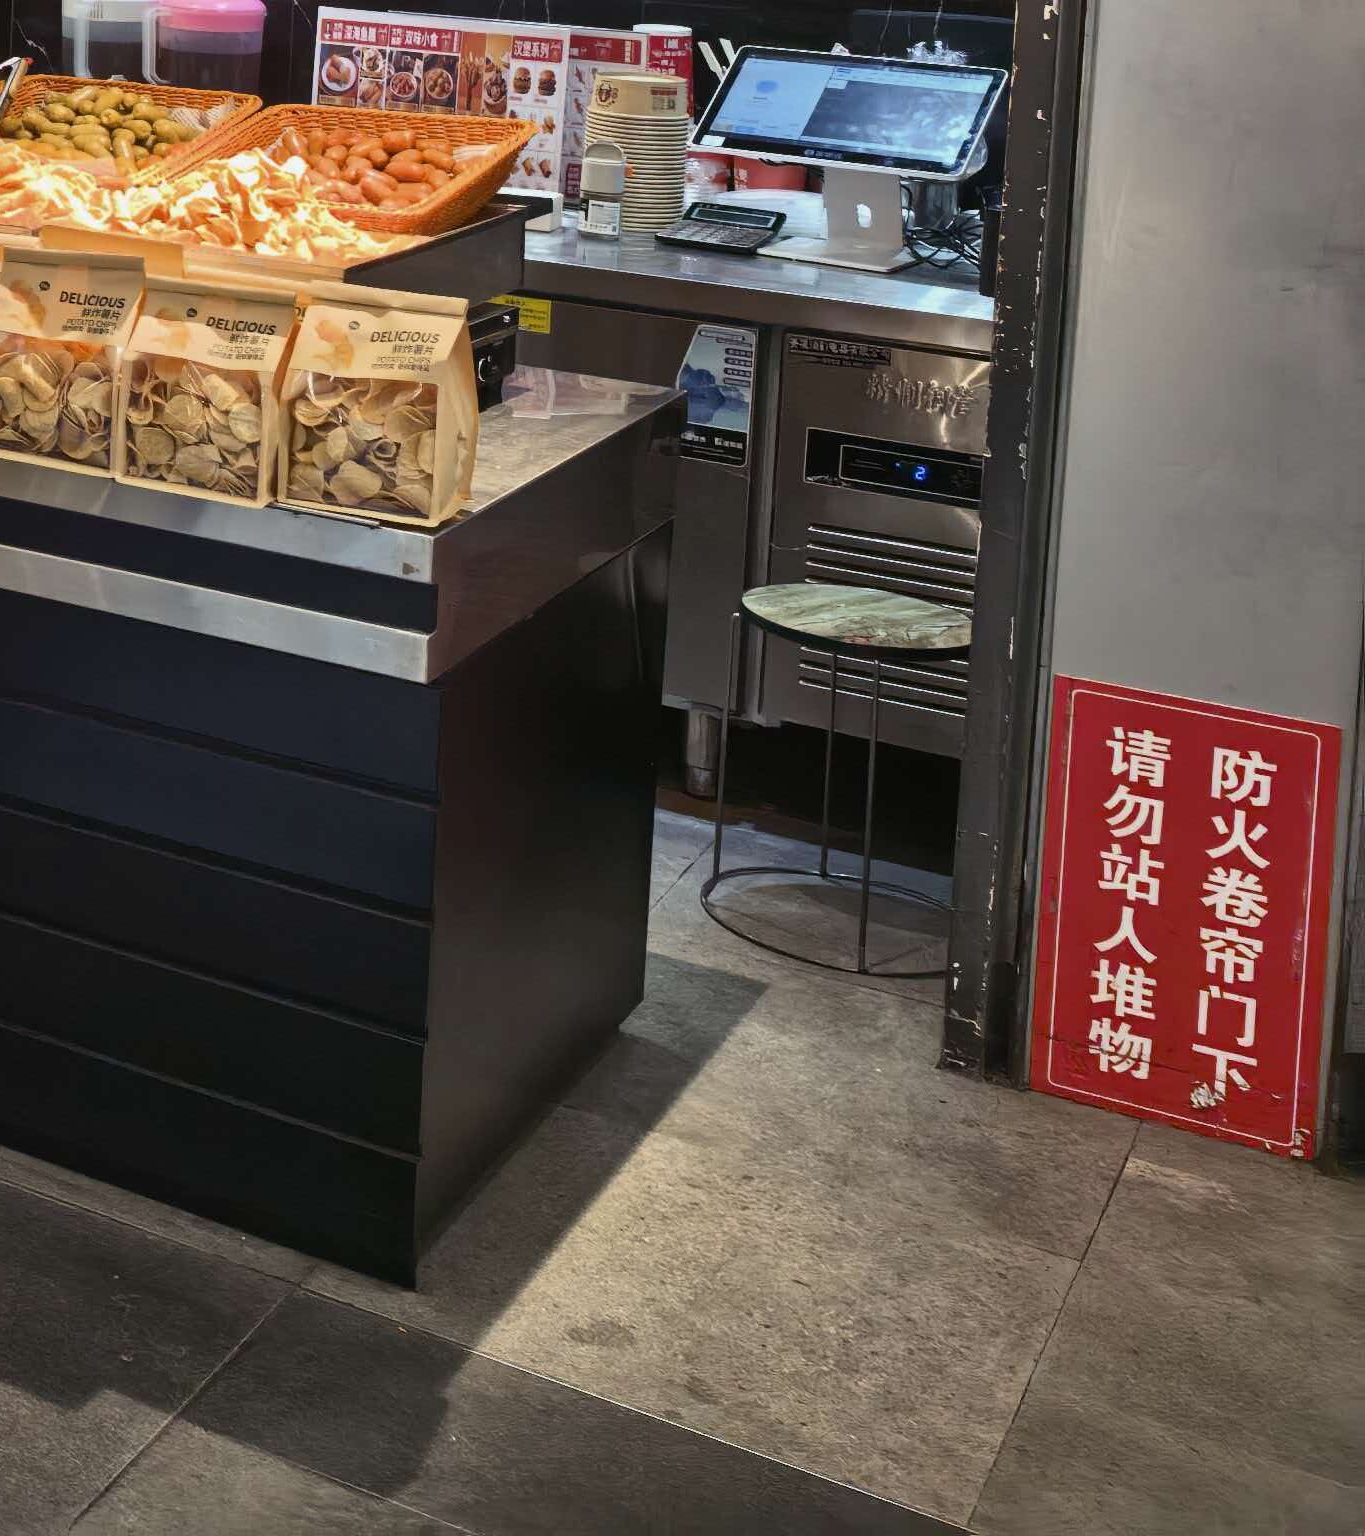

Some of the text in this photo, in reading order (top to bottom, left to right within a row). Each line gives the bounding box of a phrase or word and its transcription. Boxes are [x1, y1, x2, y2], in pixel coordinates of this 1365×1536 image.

[60, 291, 126, 309] DELICIOUS
[206, 316, 277, 336] DELICIOUS
[370, 330, 441, 344] DELICIOUS
[1088, 726, 1172, 1080] 请勿站人堆物
[1191, 746, 1278, 1102] 防火卷帘门下
